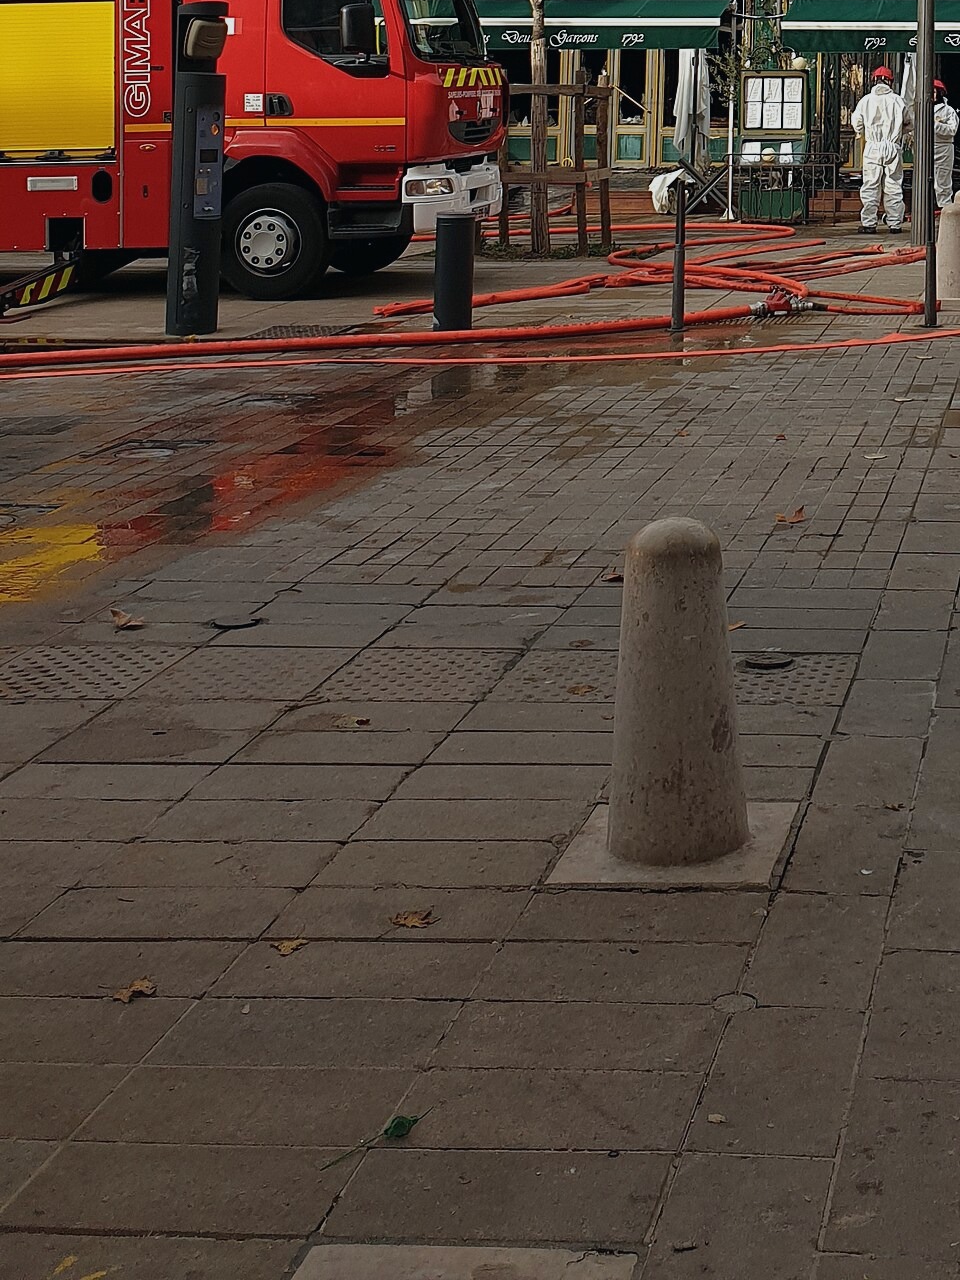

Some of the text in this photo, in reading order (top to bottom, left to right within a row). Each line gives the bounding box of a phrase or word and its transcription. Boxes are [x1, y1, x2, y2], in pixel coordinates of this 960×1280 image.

[549, 29, 599, 47] Garçons
[621, 33, 645, 47] 1792
[864, 37, 887, 50] 1792
